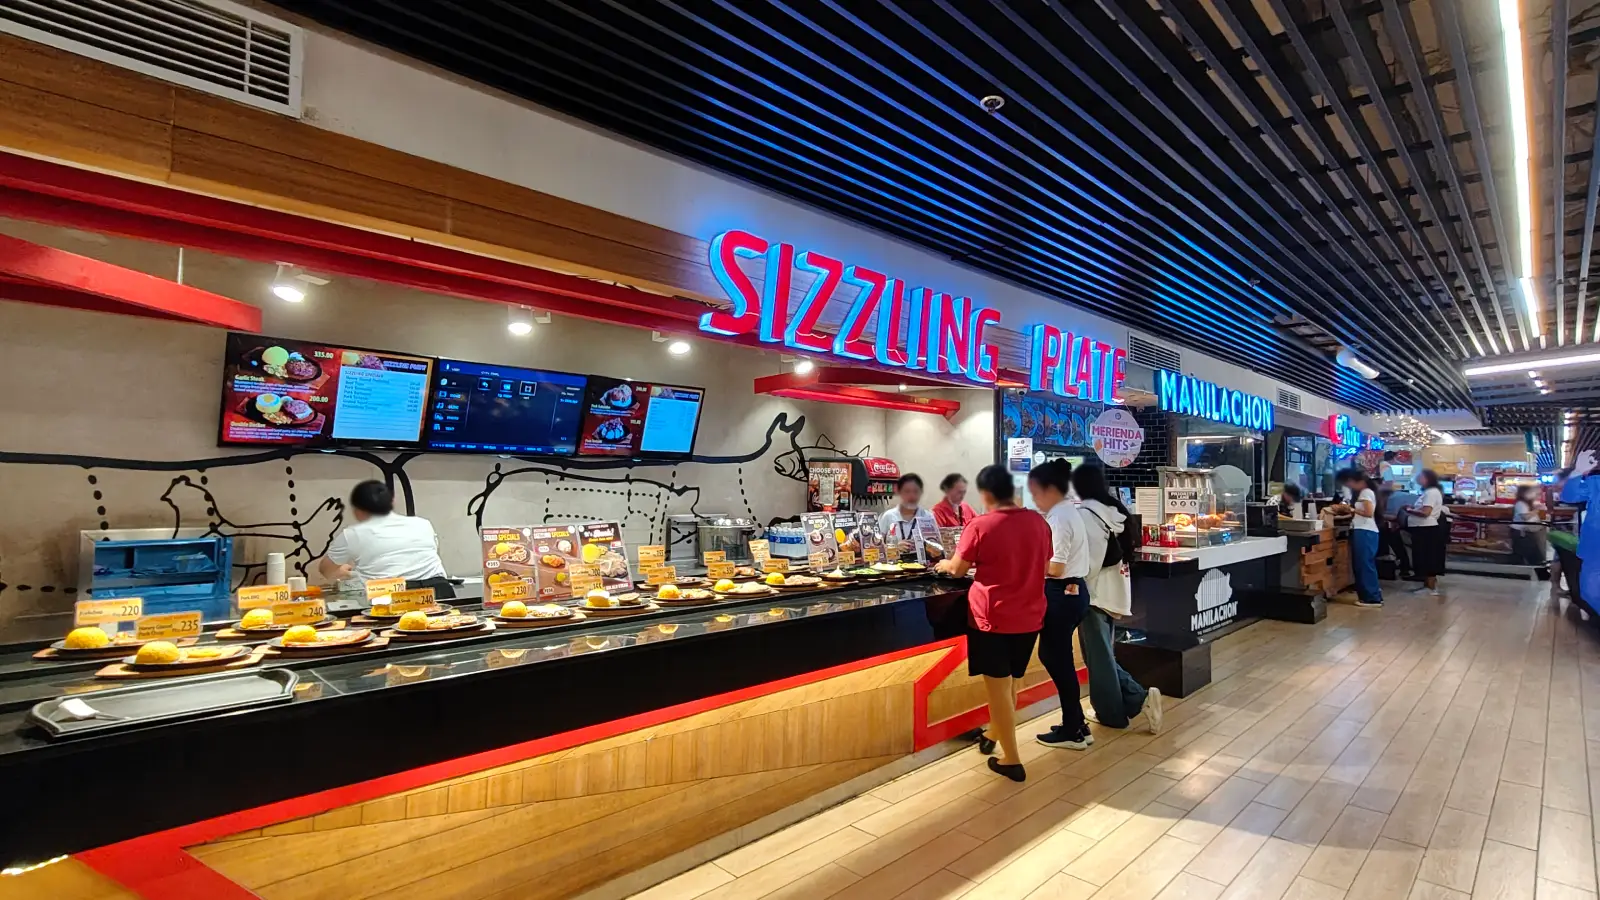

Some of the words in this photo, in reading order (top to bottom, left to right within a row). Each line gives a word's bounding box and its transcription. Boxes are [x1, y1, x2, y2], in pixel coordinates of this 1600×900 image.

[699, 230, 1001, 383] SIZZLING
[1030, 325, 1127, 406] PLATE
[1160, 369, 1274, 432] MANILACHON
[1092, 425, 1143, 441] MERIENDA
[1104, 438, 1129, 451] HITS
[832, 467, 848, 475] YOUR
[274, 590, 289, 601] 180
[121, 605, 139, 617] 220
[308, 607, 323, 617] 240
[1191, 601, 1239, 631] MANILACHON
[181, 619, 199, 632] 235
